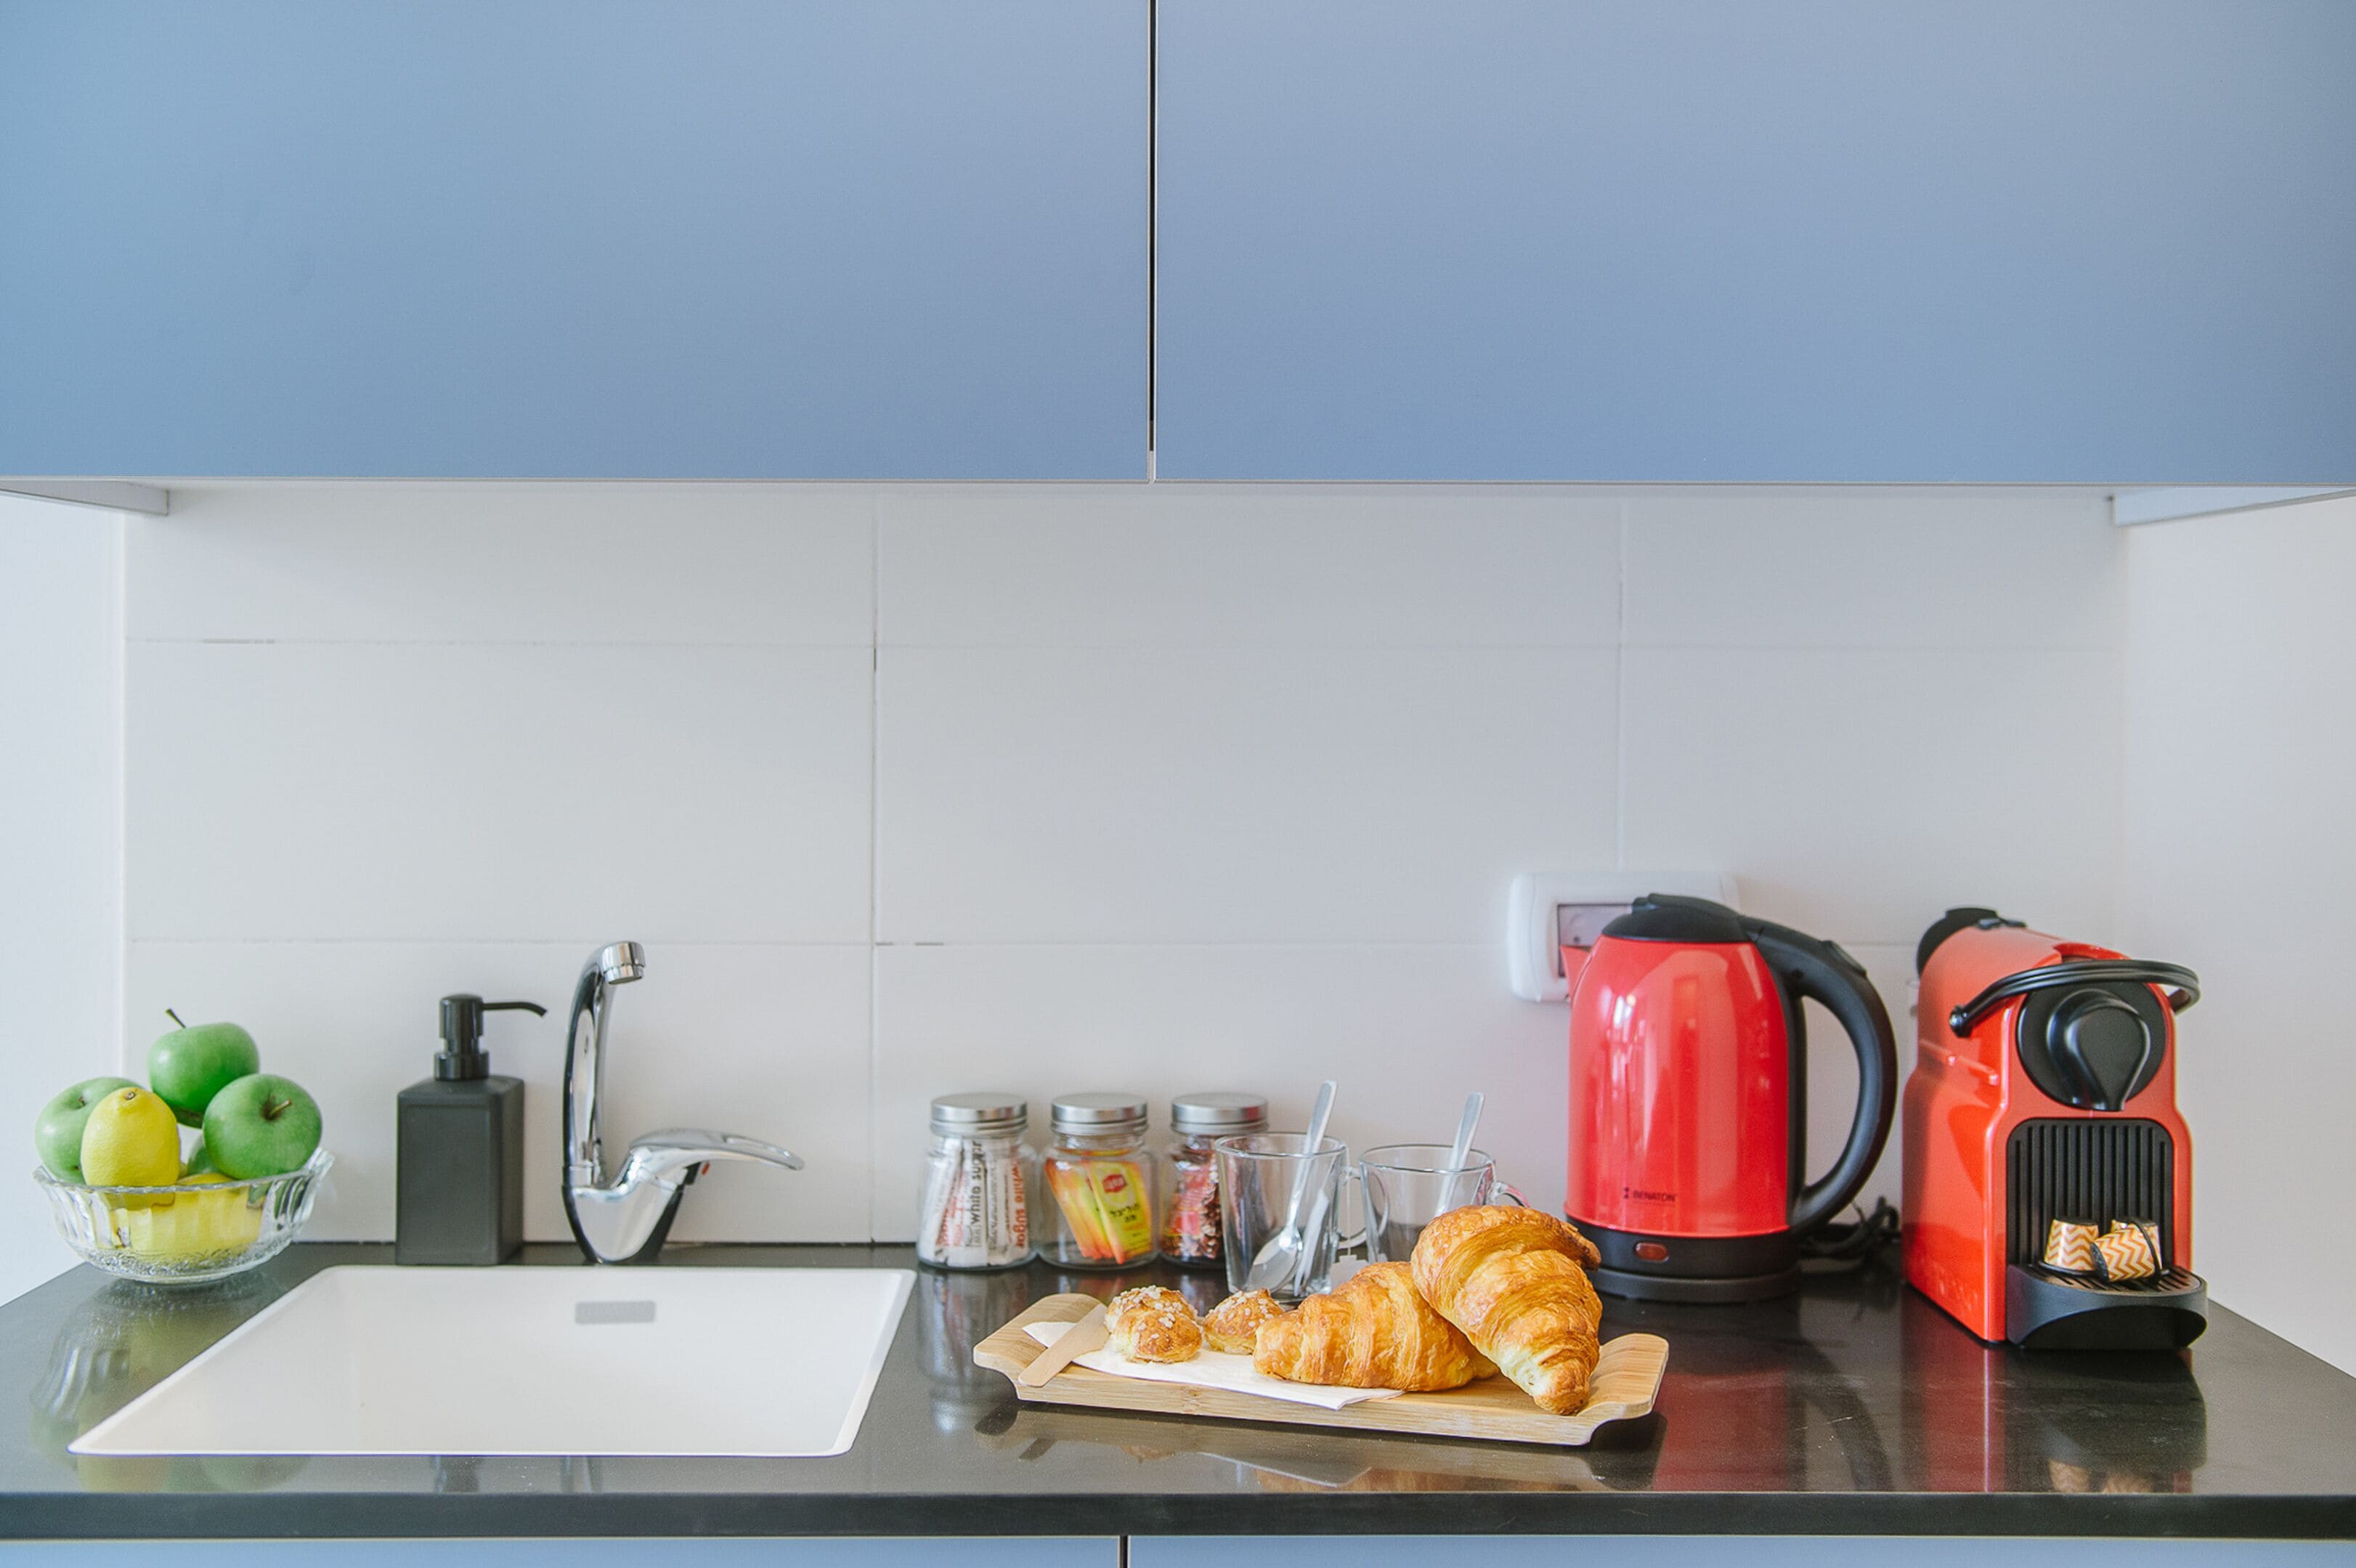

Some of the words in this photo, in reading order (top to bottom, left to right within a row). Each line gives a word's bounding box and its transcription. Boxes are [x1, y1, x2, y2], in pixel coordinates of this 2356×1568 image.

[1012, 1166, 1025, 1203] white
[967, 1186, 981, 1224] white
[1012, 1208, 1027, 1248] sugar
